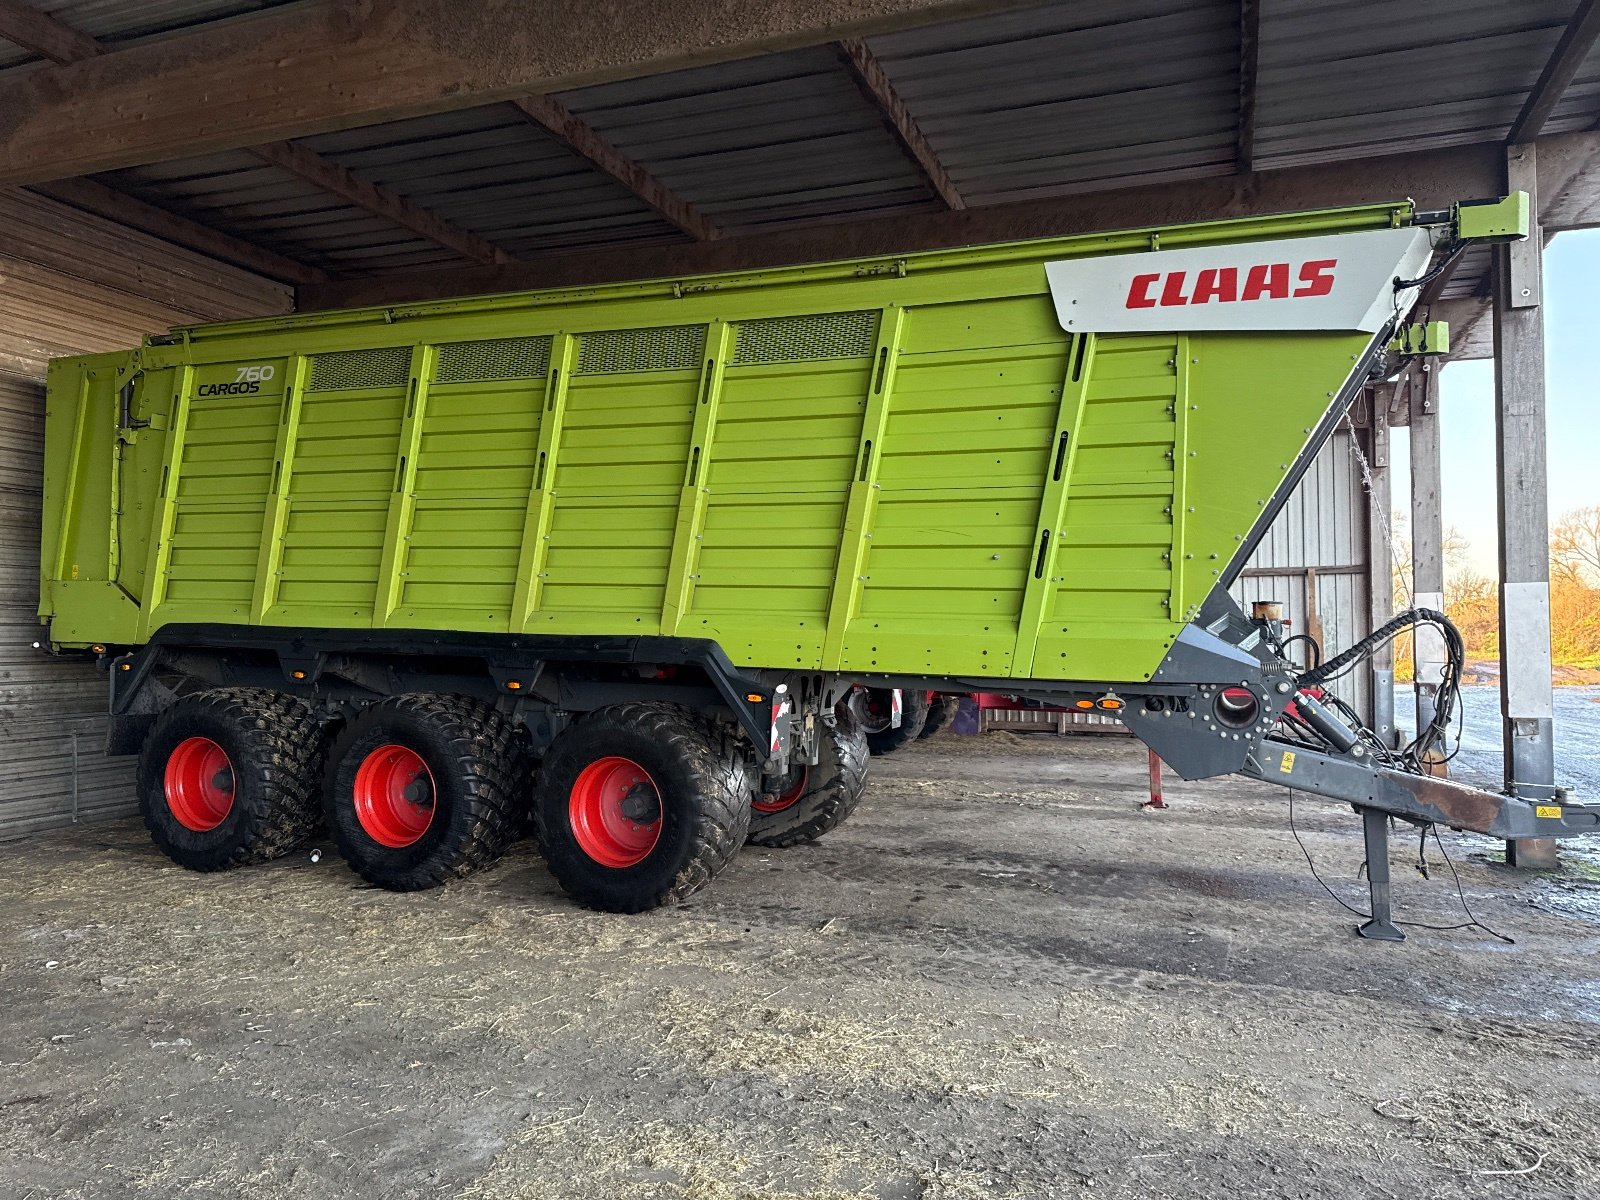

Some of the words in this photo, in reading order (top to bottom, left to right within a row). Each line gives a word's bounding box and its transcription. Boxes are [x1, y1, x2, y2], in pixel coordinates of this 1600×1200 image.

[1126, 259, 1337, 309] CLAAS
[234, 365, 274, 382] 760
[198, 381, 260, 396] CARGOS
